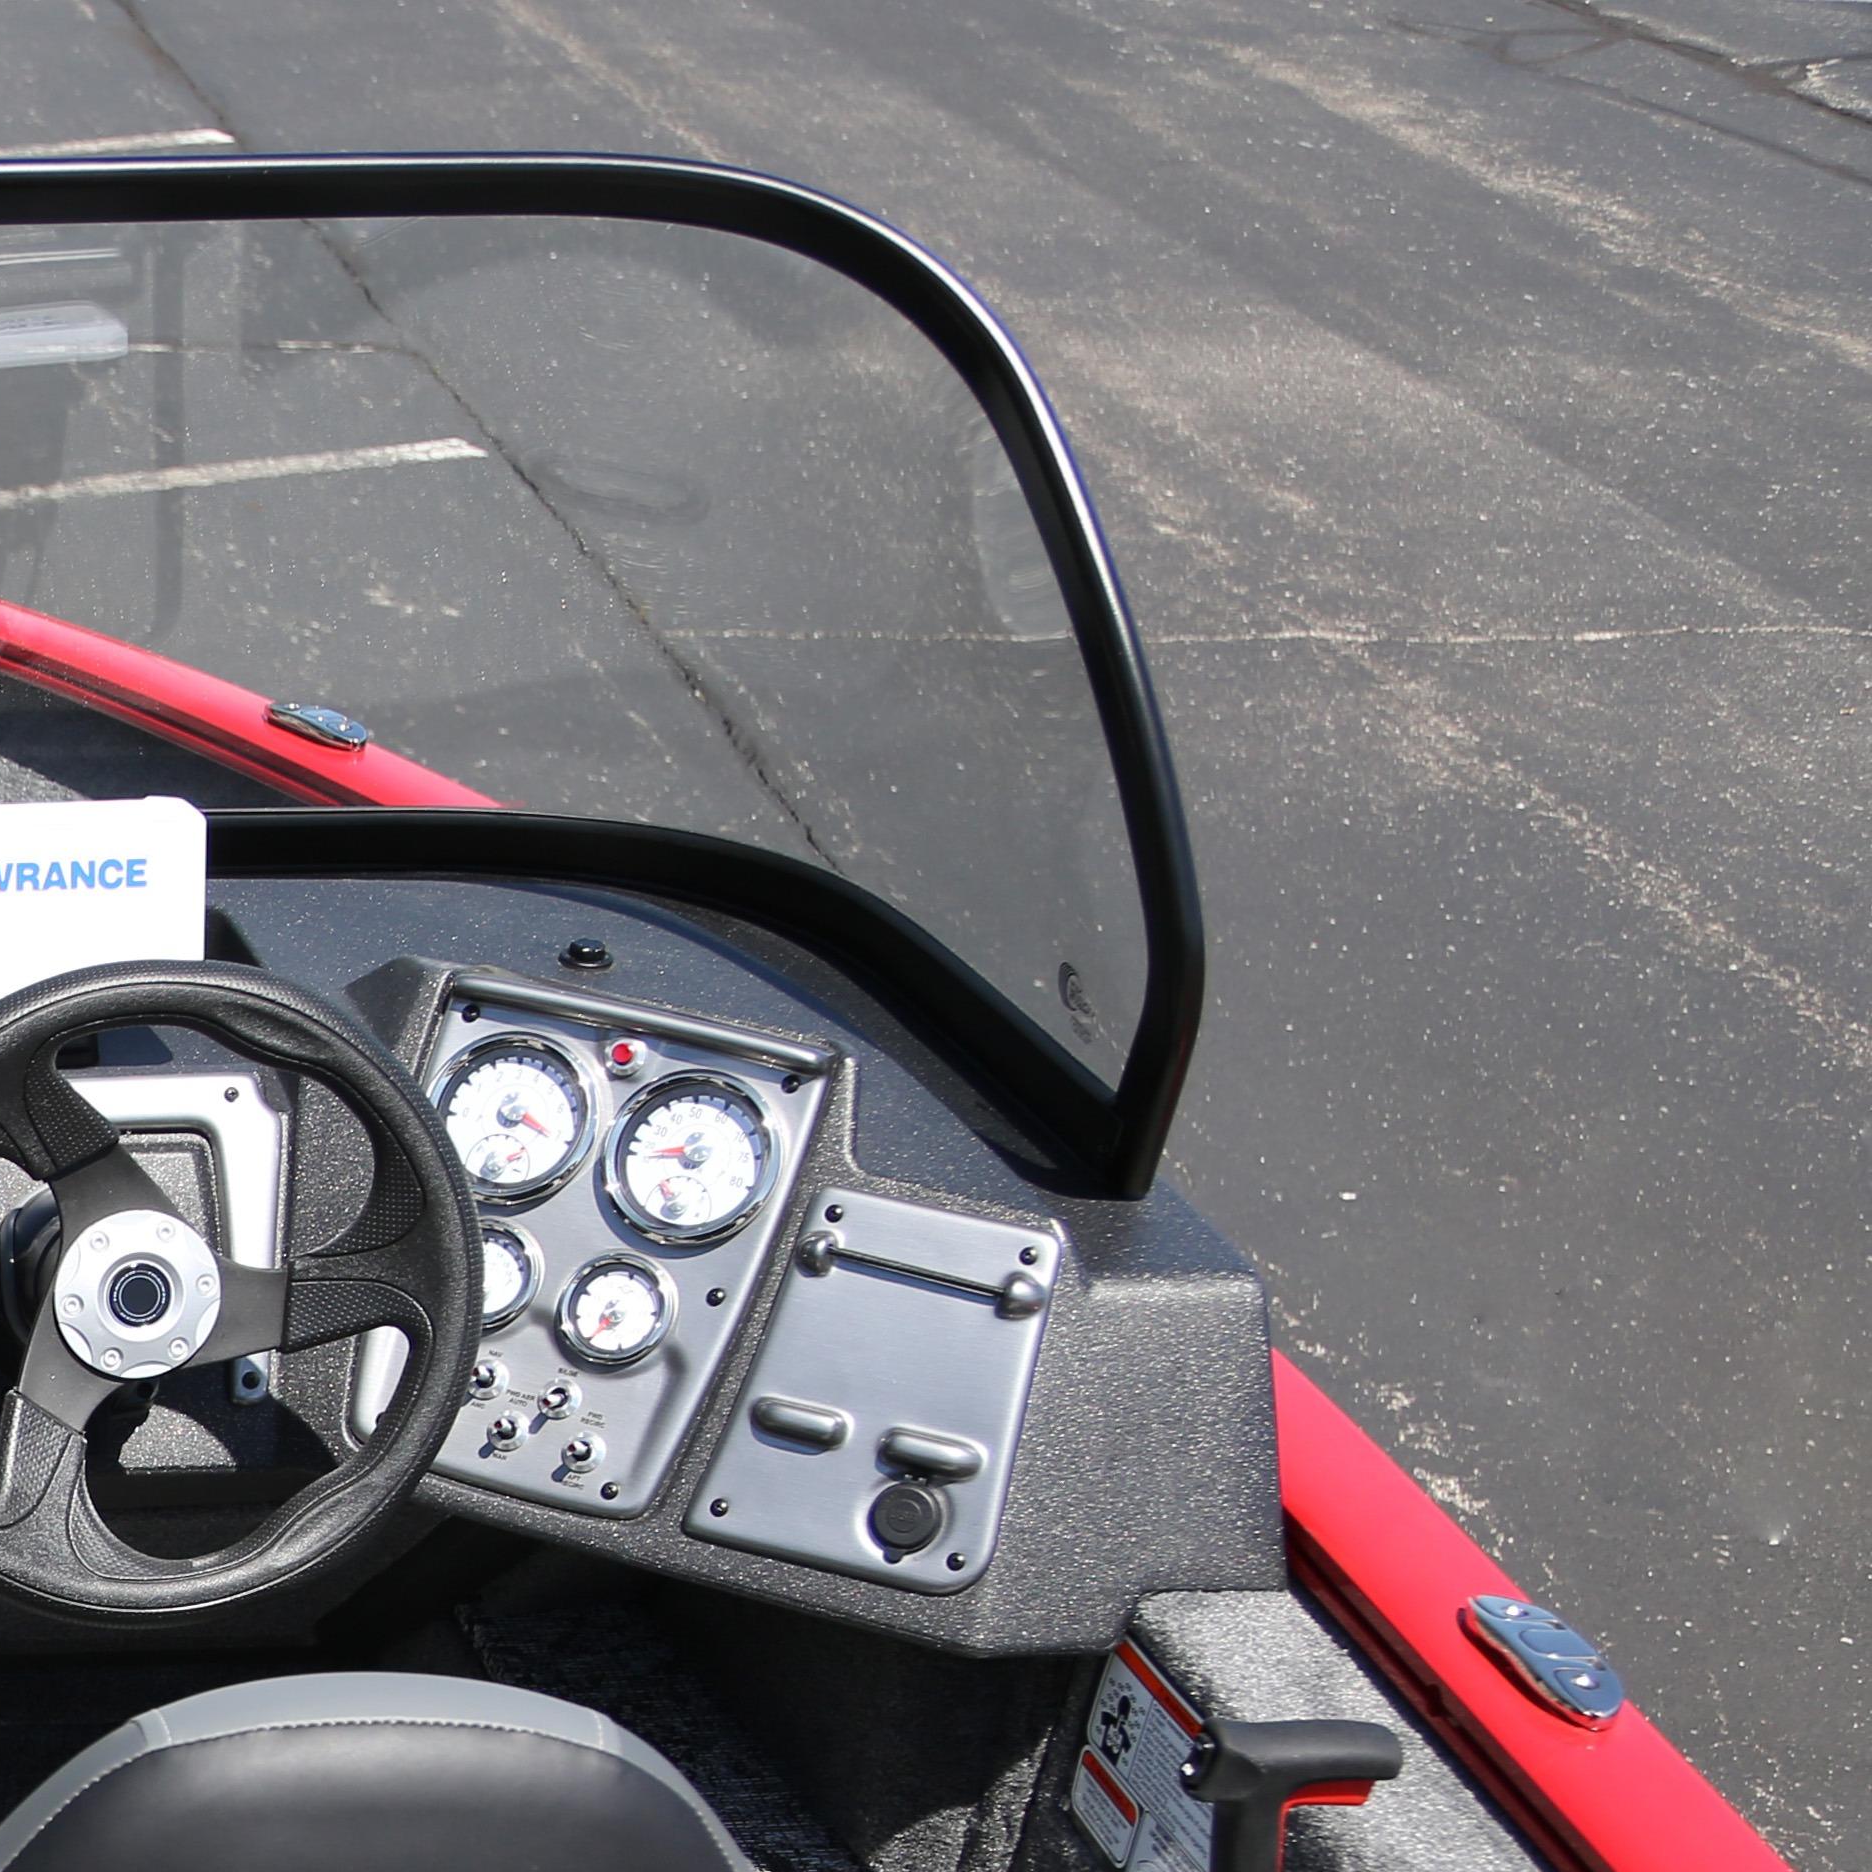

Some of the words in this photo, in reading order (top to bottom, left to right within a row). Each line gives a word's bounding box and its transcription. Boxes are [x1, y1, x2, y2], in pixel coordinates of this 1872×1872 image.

[670, 1112, 683, 1125] 40
[688, 1106, 703, 1119] 50
[714, 1112, 729, 1125] 60
[654, 1124, 668, 1137] 30
[738, 1152, 750, 1163] 75
[729, 1176, 744, 1188] 80
